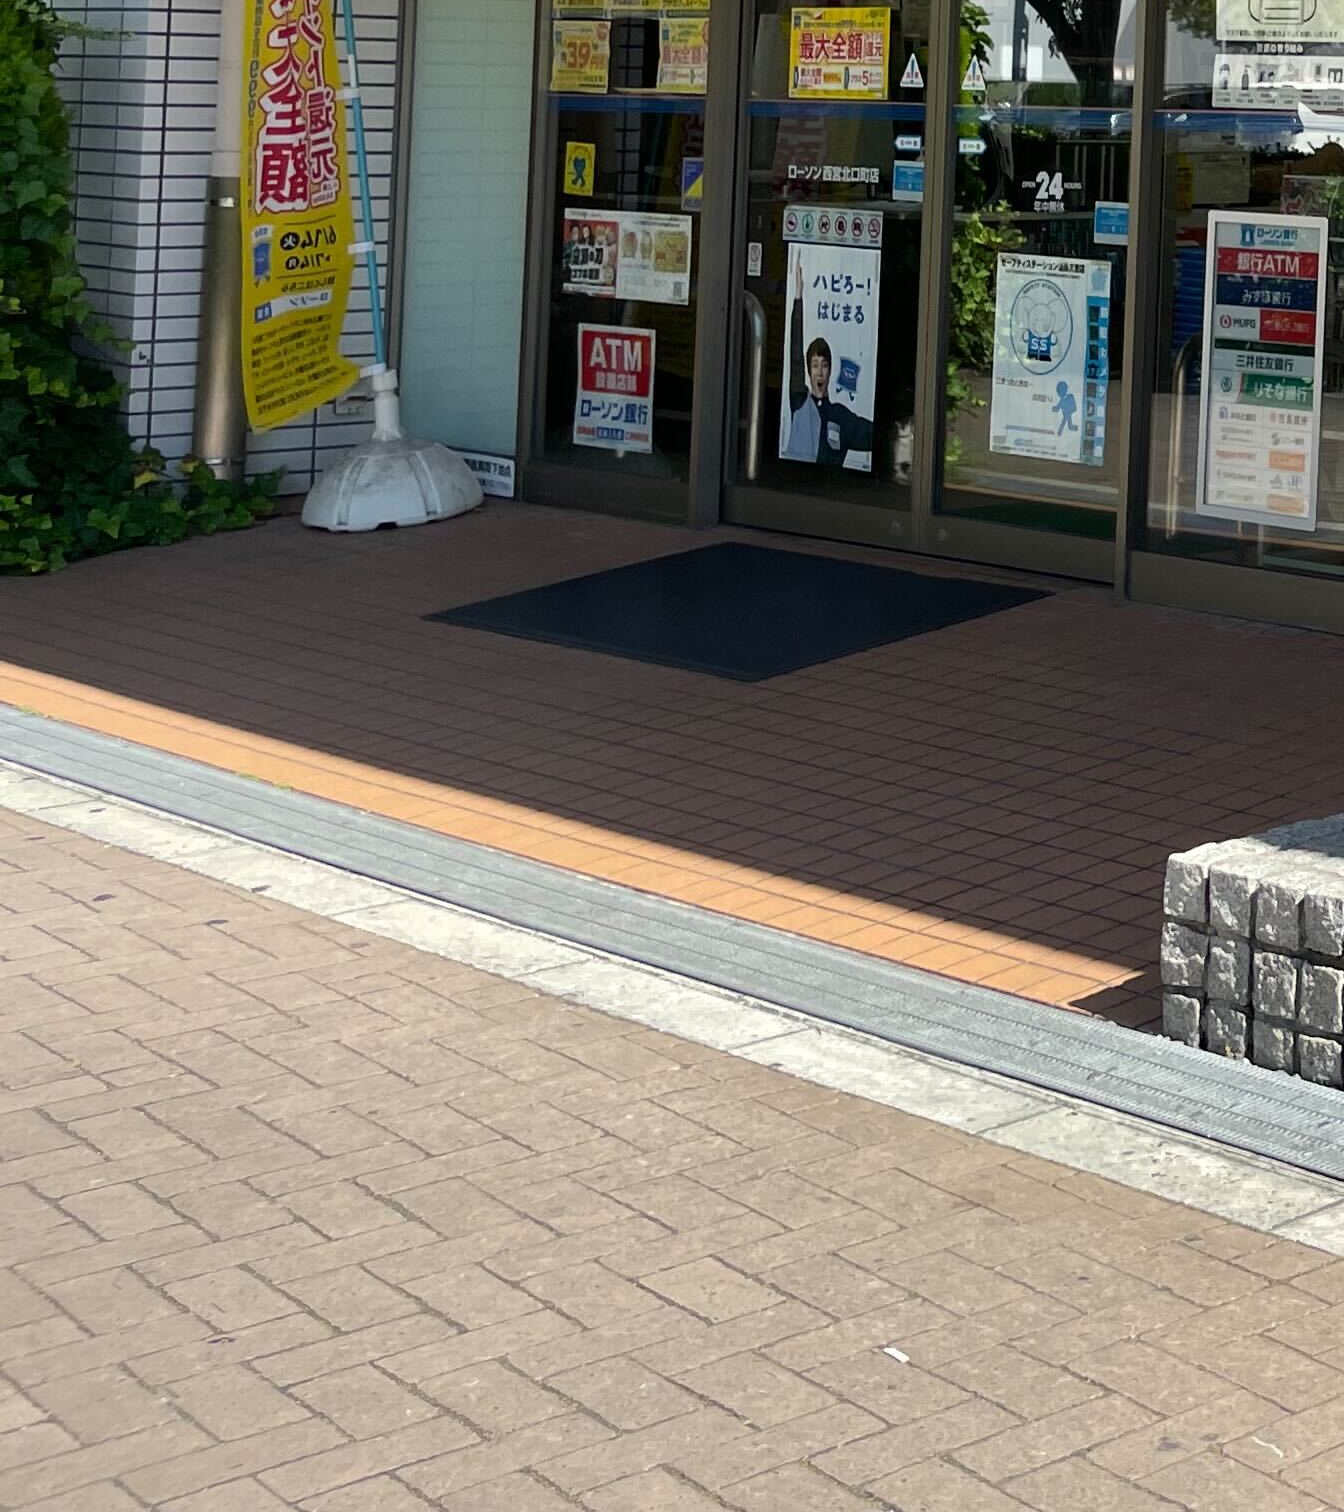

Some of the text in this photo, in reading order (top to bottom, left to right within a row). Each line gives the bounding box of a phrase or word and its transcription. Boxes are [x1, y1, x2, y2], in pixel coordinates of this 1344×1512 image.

[800, 32, 863, 60] 最大全額
[1035, 170, 1064, 200] 24
[1237, 252, 1300, 274] 銀行ATM
[813, 273, 872, 296] ハピろー!
[1241, 288, 1292, 306] みずほ銀行
[817, 301, 865, 324] はじまる
[590, 336, 642, 373] ATM
[1235, 354, 1295, 372] 三井住友銀行
[1254, 381, 1308, 403] りそな銀行
[579, 399, 649, 426] ローソン銀行
